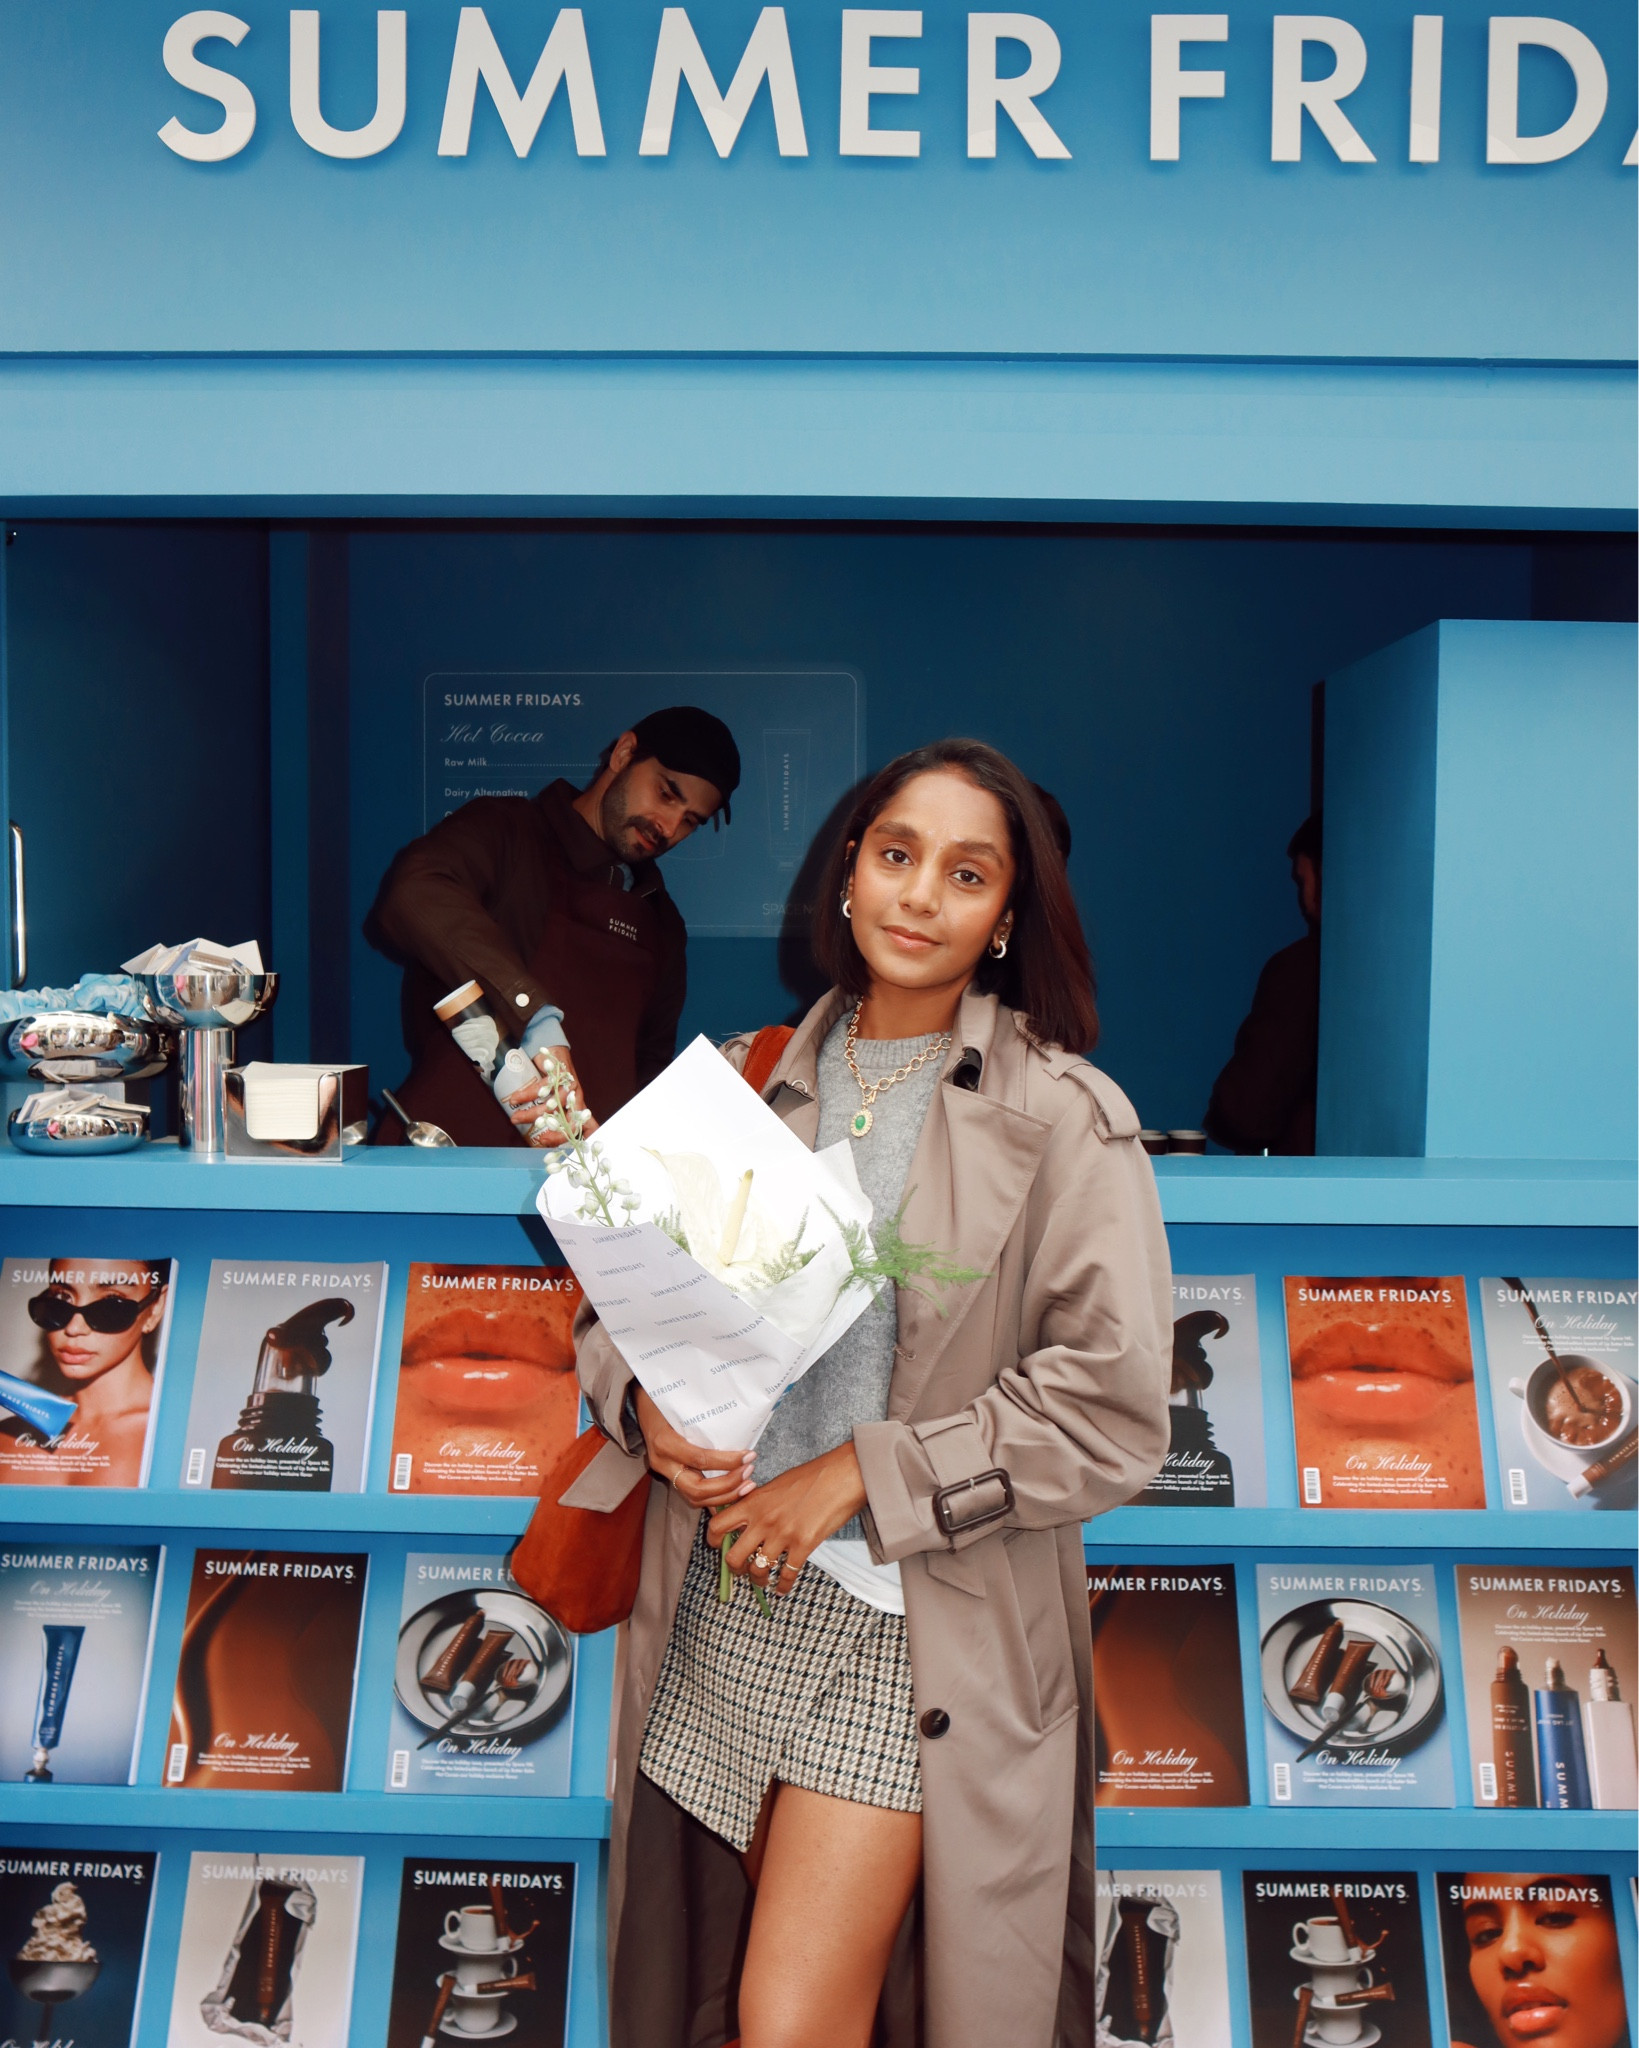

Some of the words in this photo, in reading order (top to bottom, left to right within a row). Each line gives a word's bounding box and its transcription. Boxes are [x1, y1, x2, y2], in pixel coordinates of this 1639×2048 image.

[157, 6, 1072, 162] SUMMER
[1149, 12, 1638, 167] FRID
[444, 693, 512, 707] SUMMER
[516, 693, 582, 707] FRIDAYS
[440, 722, 482, 745] Hot
[489, 722, 545, 745] Cocoa
[444, 757, 465, 767] Raw
[467, 757, 488, 767] Milk
[444, 788, 471, 800] Dairy
[473, 787, 529, 798] Alternatives
[12, 1269, 84, 1284] SUMMER
[90, 1271, 160, 1285] FRIDAYS
[222, 1271, 296, 1286] SUMMER
[302, 1273, 371, 1288] FRIDAYS
[421, 1275, 497, 1290] SUMMER
[502, 1277, 574, 1292] FRIDAYS
[1298, 1288, 1374, 1302] SUMMER
[1379, 1289, 1452, 1303] FRIDAYS
[1496, 1289, 1572, 1303] SUMMER
[1534, 1314, 1554, 1329] On
[1559, 1314, 1618, 1336] Holiday
[639, 1346, 666, 1361] SUMMER
[710, 1358, 739, 1375] SUMMER
[706, 1399, 738, 1419] FRIDAYS
[15, 1432, 37, 1448] On
[40, 1432, 100, 1457] Holiday
[232, 1437, 255, 1452] On
[258, 1436, 319, 1461] Holiday
[439, 1441, 461, 1456] On
[465, 1441, 526, 1466] Holiday
[1345, 1454, 1368, 1470] On
[1372, 1454, 1432, 1479] Holiday
[1, 1553, 74, 1570] SUMMER
[78, 1556, 148, 1572] FRIDAYS
[205, 1560, 279, 1577] SUMMER
[284, 1564, 354, 1579] FRIDAYS
[417, 1566, 492, 1581] SUMMER
[53, 1580, 111, 1604] Holiday
[1151, 1577, 1222, 1592] FRIDAYS
[1269, 1577, 1344, 1591] SUMMER
[1349, 1578, 1421, 1593] FRIDAYS
[1469, 1577, 1544, 1592] SUMMER
[1548, 1579, 1621, 1593] FRIDAYS
[1506, 1604, 1528, 1619] On
[1532, 1603, 1589, 1627] Holiday
[213, 1733, 236, 1748] On
[239, 1732, 299, 1758] Holiday
[436, 1738, 459, 1754] On
[462, 1737, 522, 1763] Holiday
[1112, 1749, 1135, 1765] On
[1138, 1748, 1198, 1773] Holiday
[1315, 1749, 1338, 1766] On
[1341, 1748, 1402, 1773] Holiday
[0, 1859, 70, 1877] SUMMER
[73, 1862, 143, 1879] FRIDAYS
[202, 1864, 275, 1881] SUMMER
[279, 1866, 349, 1883] FRIDAYS
[413, 1870, 488, 1887] SUMMER
[492, 1873, 562, 1890] FRIDAYS
[1136, 1883, 1207, 1898] FRIDAYS
[1256, 1882, 1330, 1898] SUMMER
[1334, 1883, 1406, 1899] FRIDAYS
[1450, 1885, 1524, 1901] SUMMER
[1528, 1886, 1599, 1902] FRIDAYS
